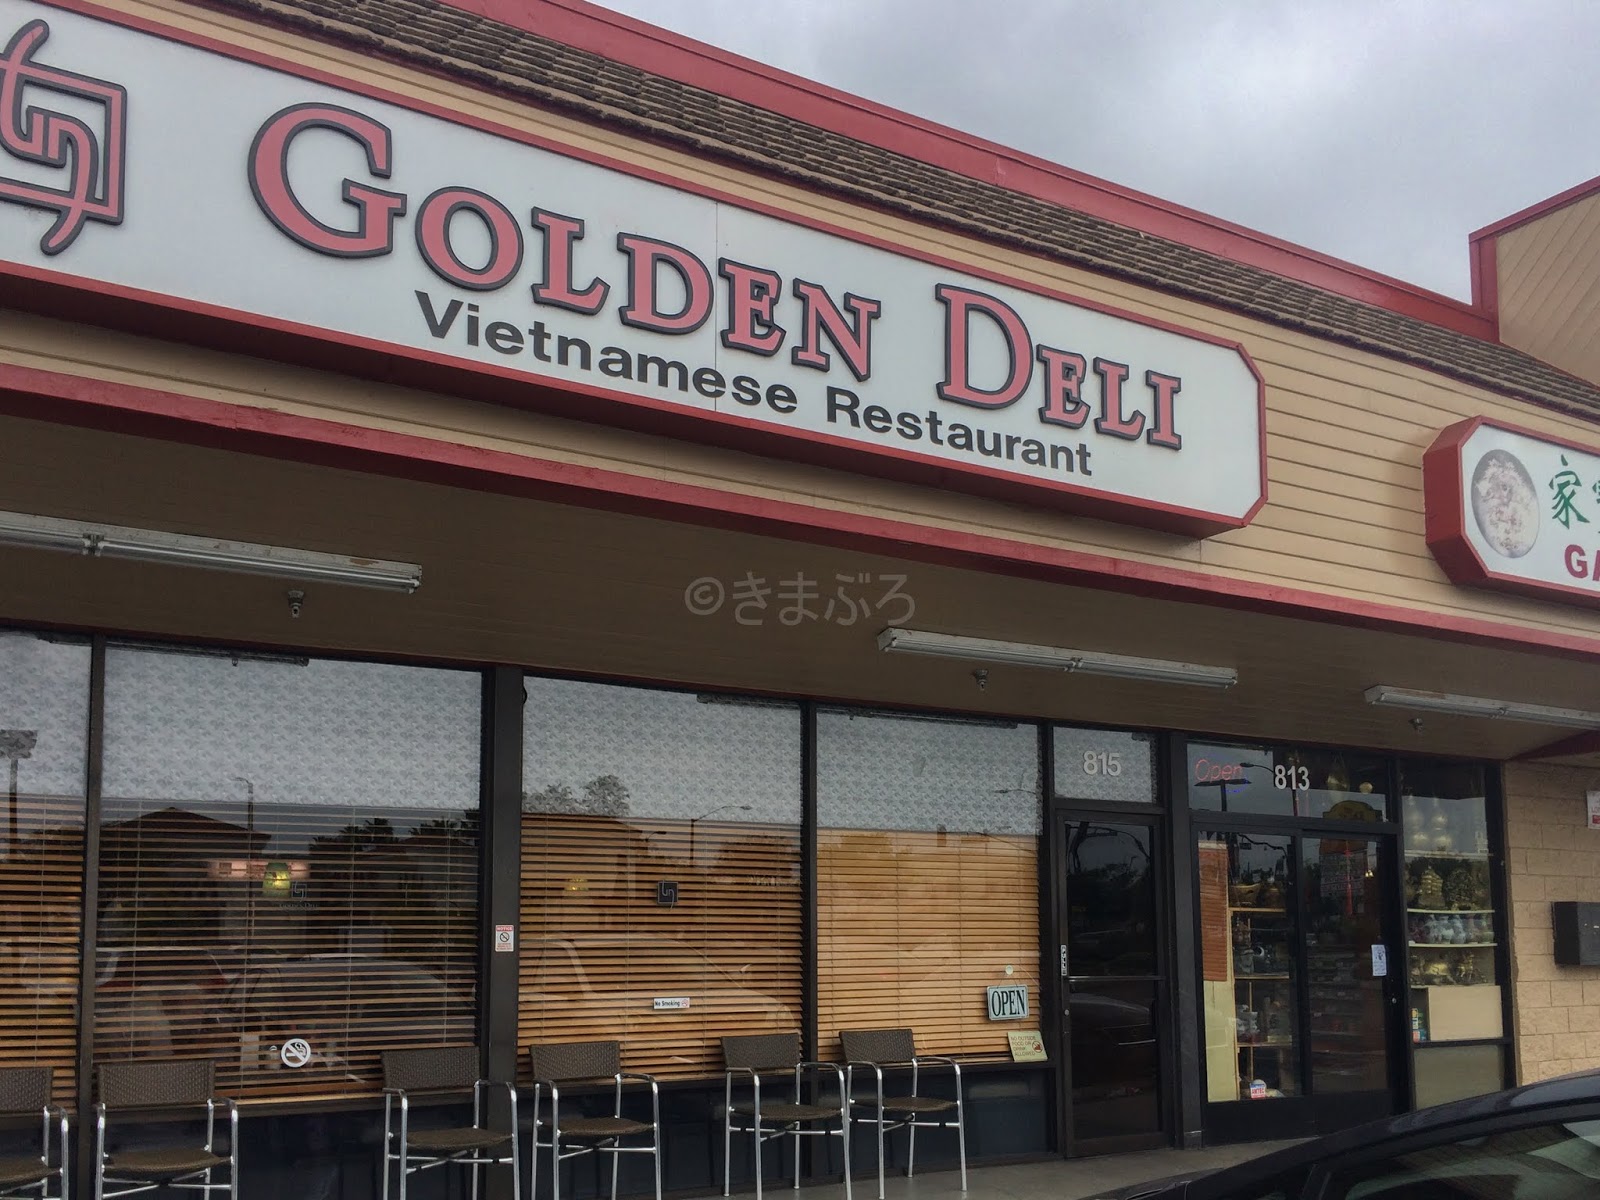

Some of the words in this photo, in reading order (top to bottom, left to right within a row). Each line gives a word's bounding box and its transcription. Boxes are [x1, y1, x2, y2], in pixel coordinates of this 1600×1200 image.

[247, 102, 881, 382] GOLDEN
[935, 282, 1182, 450] DELI
[414, 289, 798, 413] Vietnamese
[826, 385, 1092, 476] Restaurant
[1548, 454, 1600, 534] 家
[1083, 750, 1121, 777] 815
[1195, 758, 1244, 783] Open
[1274, 764, 1310, 791] 813
[991, 989, 1026, 1017] OPEN
